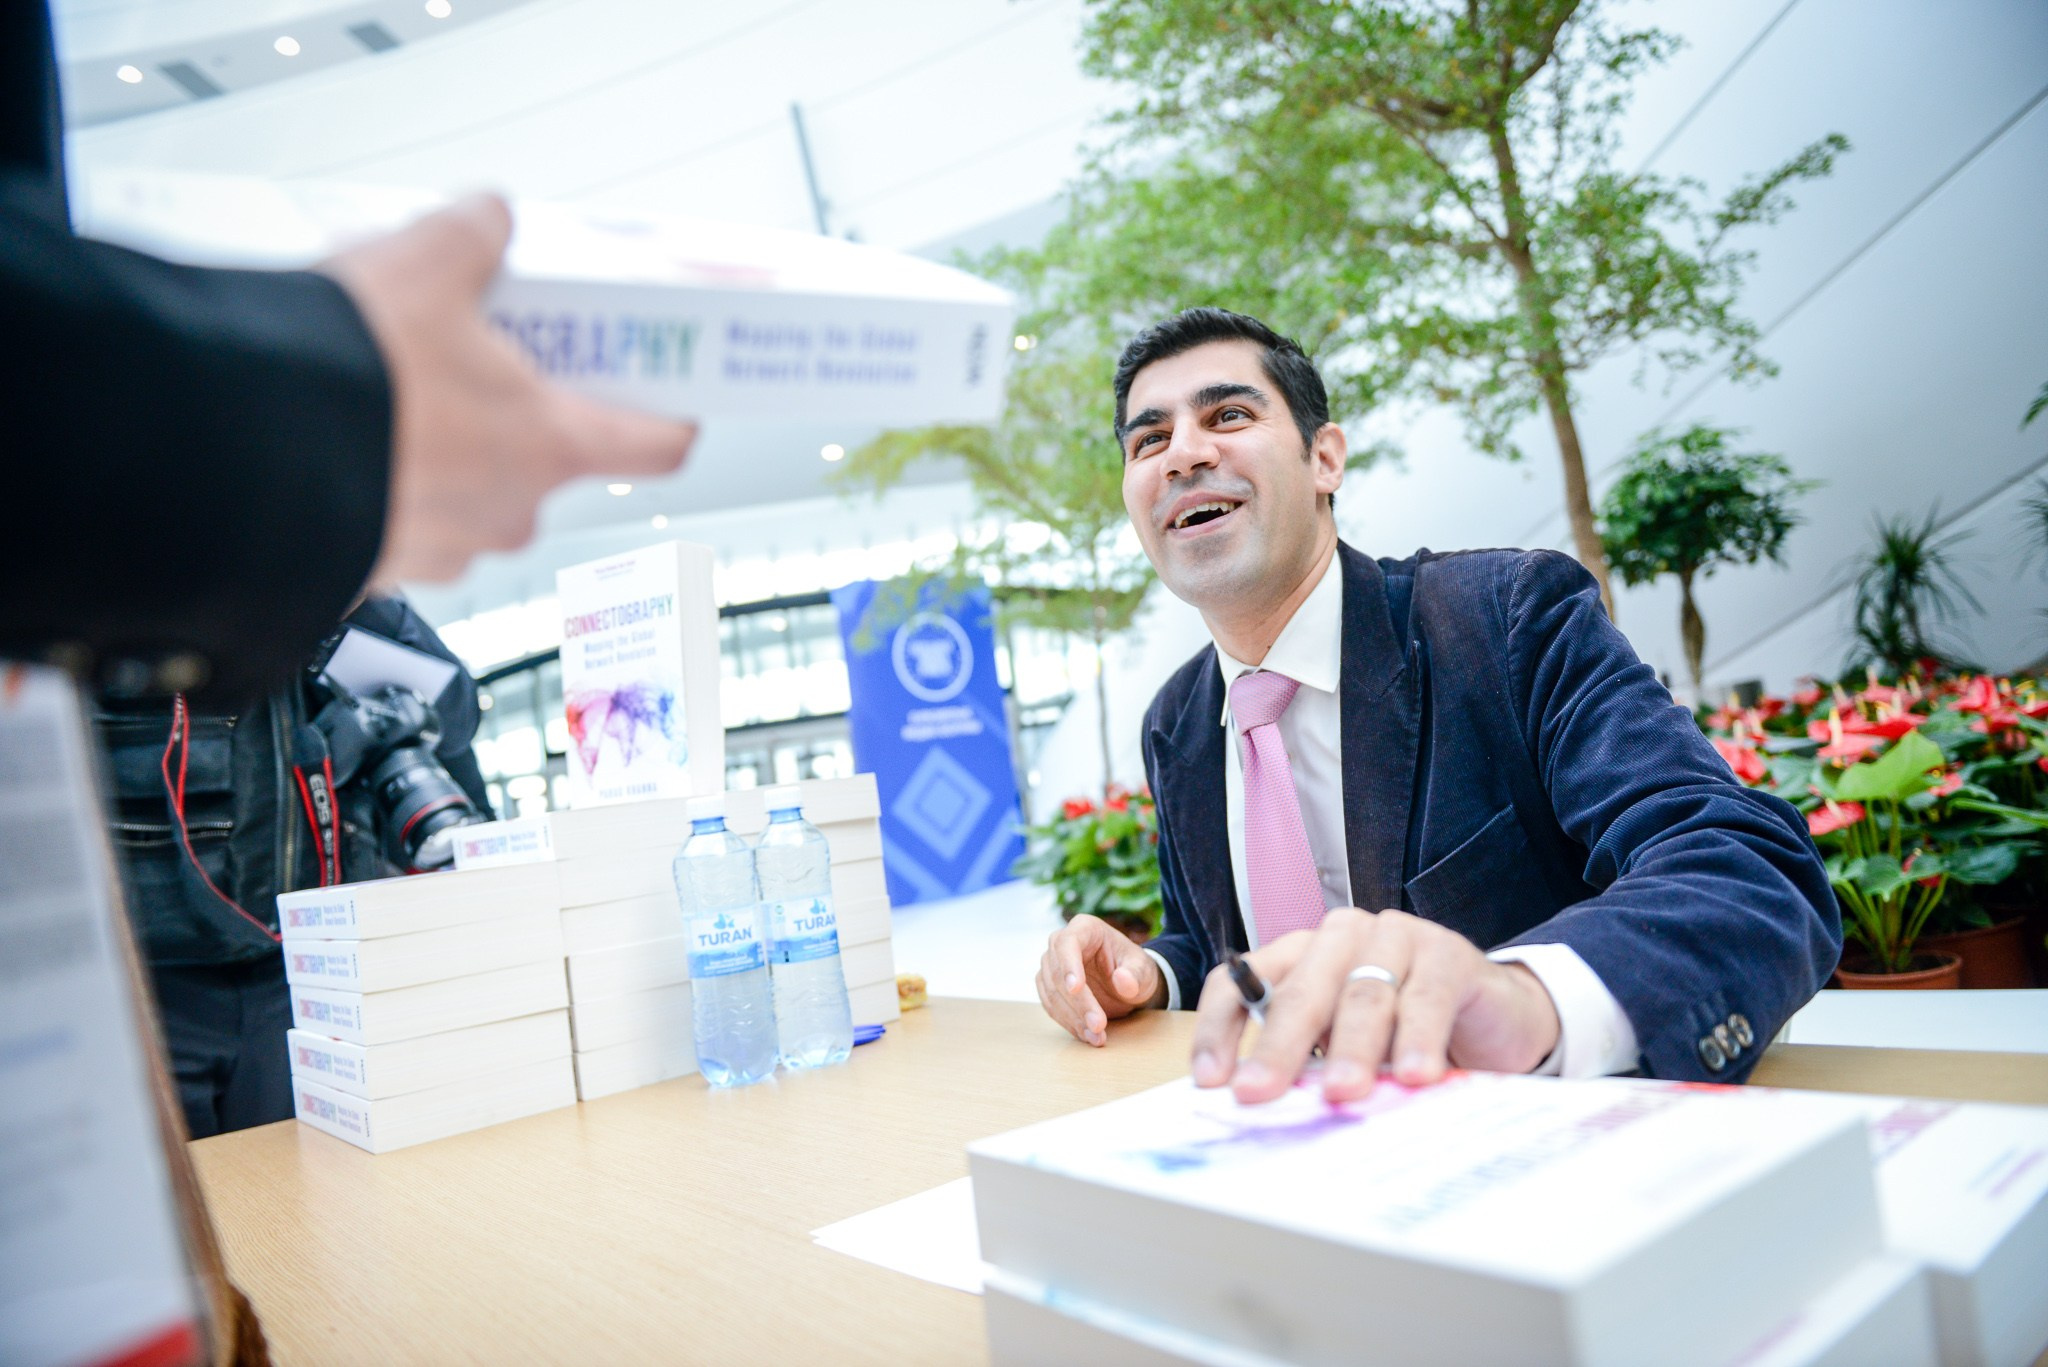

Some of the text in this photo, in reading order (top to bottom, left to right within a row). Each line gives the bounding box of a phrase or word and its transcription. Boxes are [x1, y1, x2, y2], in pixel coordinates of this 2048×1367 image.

[564, 593, 673, 640] CONNECTOGRAPHY
[309, 773, 332, 825] EOS
[698, 926, 752, 947] TURAN
